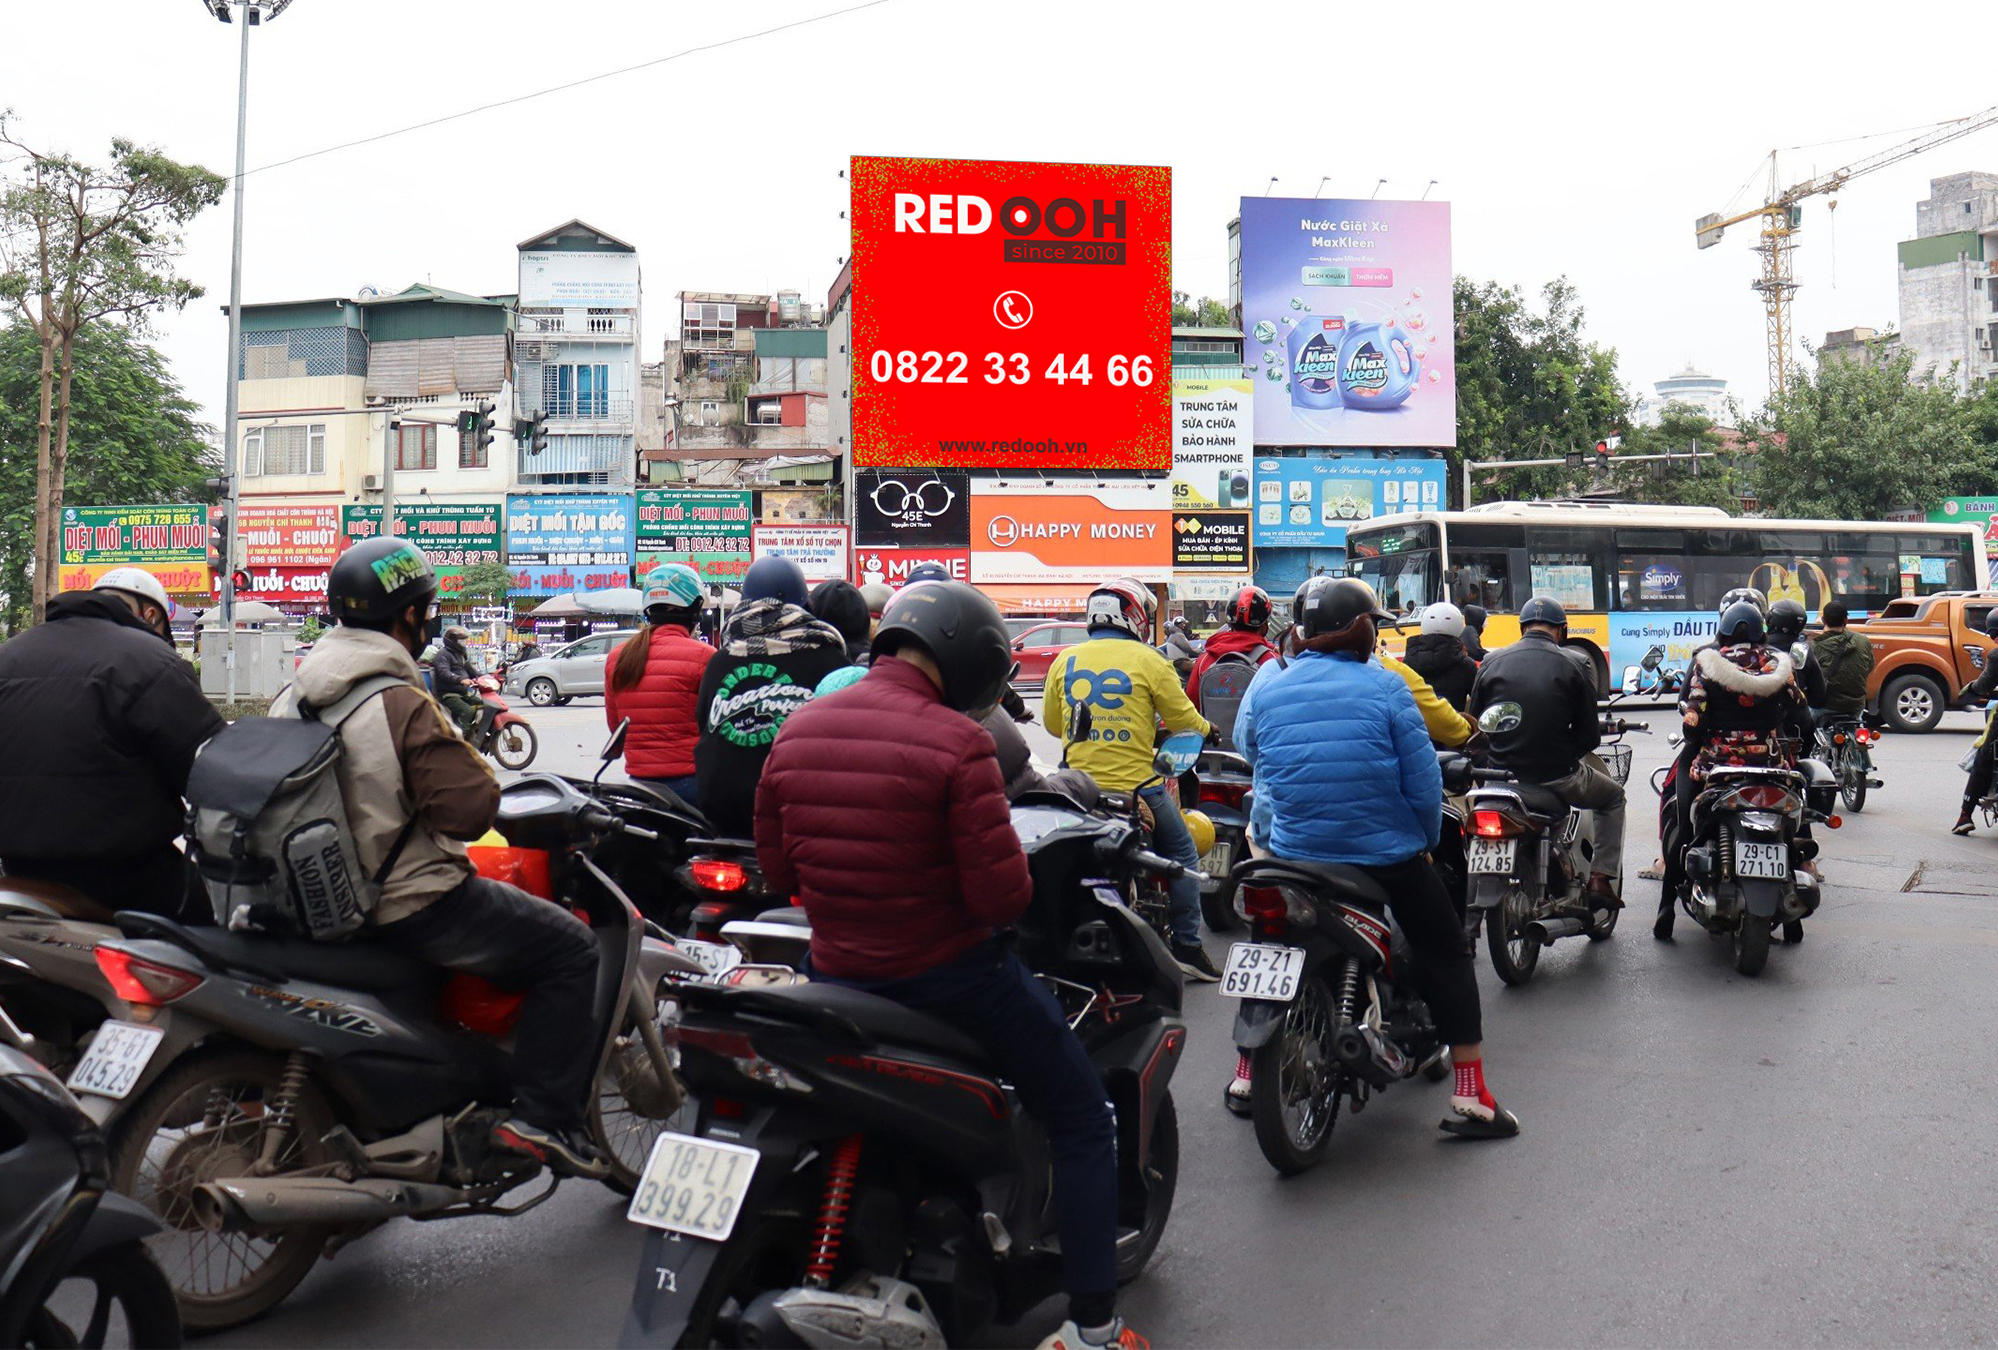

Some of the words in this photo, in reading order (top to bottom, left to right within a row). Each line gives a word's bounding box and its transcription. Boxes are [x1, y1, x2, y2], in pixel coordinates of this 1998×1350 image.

[895, 193, 992, 234] RED
[1000, 196, 1126, 239] OOH
[1302, 220, 1336, 232] Nước
[1341, 220, 1368, 234] Giặt
[1312, 236, 1375, 248] MaxKleen
[1012, 244, 1065, 260] since
[1072, 245, 1118, 261] 2010
[871, 350, 968, 384] 0822
[984, 352, 1030, 385] 33
[1045, 353, 1093, 386] 44
[1107, 354, 1153, 386] 66
[1353, 358, 1387, 370] Max
[1342, 368, 1384, 380] kleen
[1180, 402, 1214, 412] TRUNG
[1216, 400, 1238, 412] TÂM
[1182, 418, 1204, 428] SỬA
[1206, 417, 1236, 428] CHỮA
[938, 438, 1088, 454] www.redooh.vn
[1182, 436, 1204, 446] BẢO
[1206, 435, 1236, 446] HÀNH
[1174, 454, 1243, 463] SMARTPHONE
[1172, 484, 1188, 496] 45
[400, 506, 414, 514] MỐI
[639, 504, 662, 523] DIỆT
[664, 502, 684, 520] MỐI
[692, 507, 720, 520] PHUN
[722, 502, 748, 520] MUỖI
[1965, 501, 1996, 512] BÁNH
[128, 515, 151, 525] 0975
[154, 514, 171, 524] 728
[174, 514, 191, 524] 655
[248, 517, 275, 526] NGUYỄN
[276, 518, 289, 526] CHÍ
[510, 512, 538, 534] DIỆT
[542, 510, 566, 530] MỐI
[570, 512, 596, 534] TẬN
[599, 510, 626, 530] GỐC
[902, 511, 923, 521] 45E
[348, 519, 376, 537] DIỆT
[419, 520, 458, 534] PHUN
[460, 515, 496, 534] MUỖI
[1021, 524, 1082, 538] HAPPY
[1090, 524, 1156, 538] MONEY
[1204, 526, 1244, 534] MOBILE
[65, 522, 92, 556] DIỆT
[96, 518, 121, 550] MỐI
[133, 526, 168, 549] PHUN
[171, 516, 205, 548] MUỖI
[248, 528, 280, 545] MUỖI
[293, 528, 336, 547] CHUỘT
[781, 538, 794, 546] TÂM
[806, 536, 814, 546] SỐ
[825, 538, 842, 548] CHỌN
[726, 537, 736, 552] 32
[738, 537, 750, 552] 72
[786, 548, 798, 556] TÂM
[306, 555, 332, 564] (Ngân)
[465, 551, 481, 565] 32
[64, 567, 91, 589] MỐI
[291, 572, 329, 595] CHUỘ
[1646, 568, 1680, 586] Simply
[1022, 598, 1071, 607] HAPPY
[1642, 623, 1670, 638] Simply
[1673, 616, 1702, 636] ĐẦU
[1064, 656, 1132, 710] be
[1474, 840, 1510, 856] 29-S1
[1744, 844, 1780, 860] 29-C1
[1471, 856, 1512, 872] 124.85
[1739, 860, 1784, 878] 271.10
[296, 855, 332, 930] FASHION
[1344, 914, 1382, 940] BLADE
[1238, 948, 1292, 972] 29-Z1
[1226, 972, 1292, 996] 691.46
[74, 1065, 136, 1093] 045.29
[664, 1142, 740, 1194] 18-L1
[638, 1180, 734, 1232] 399.29
